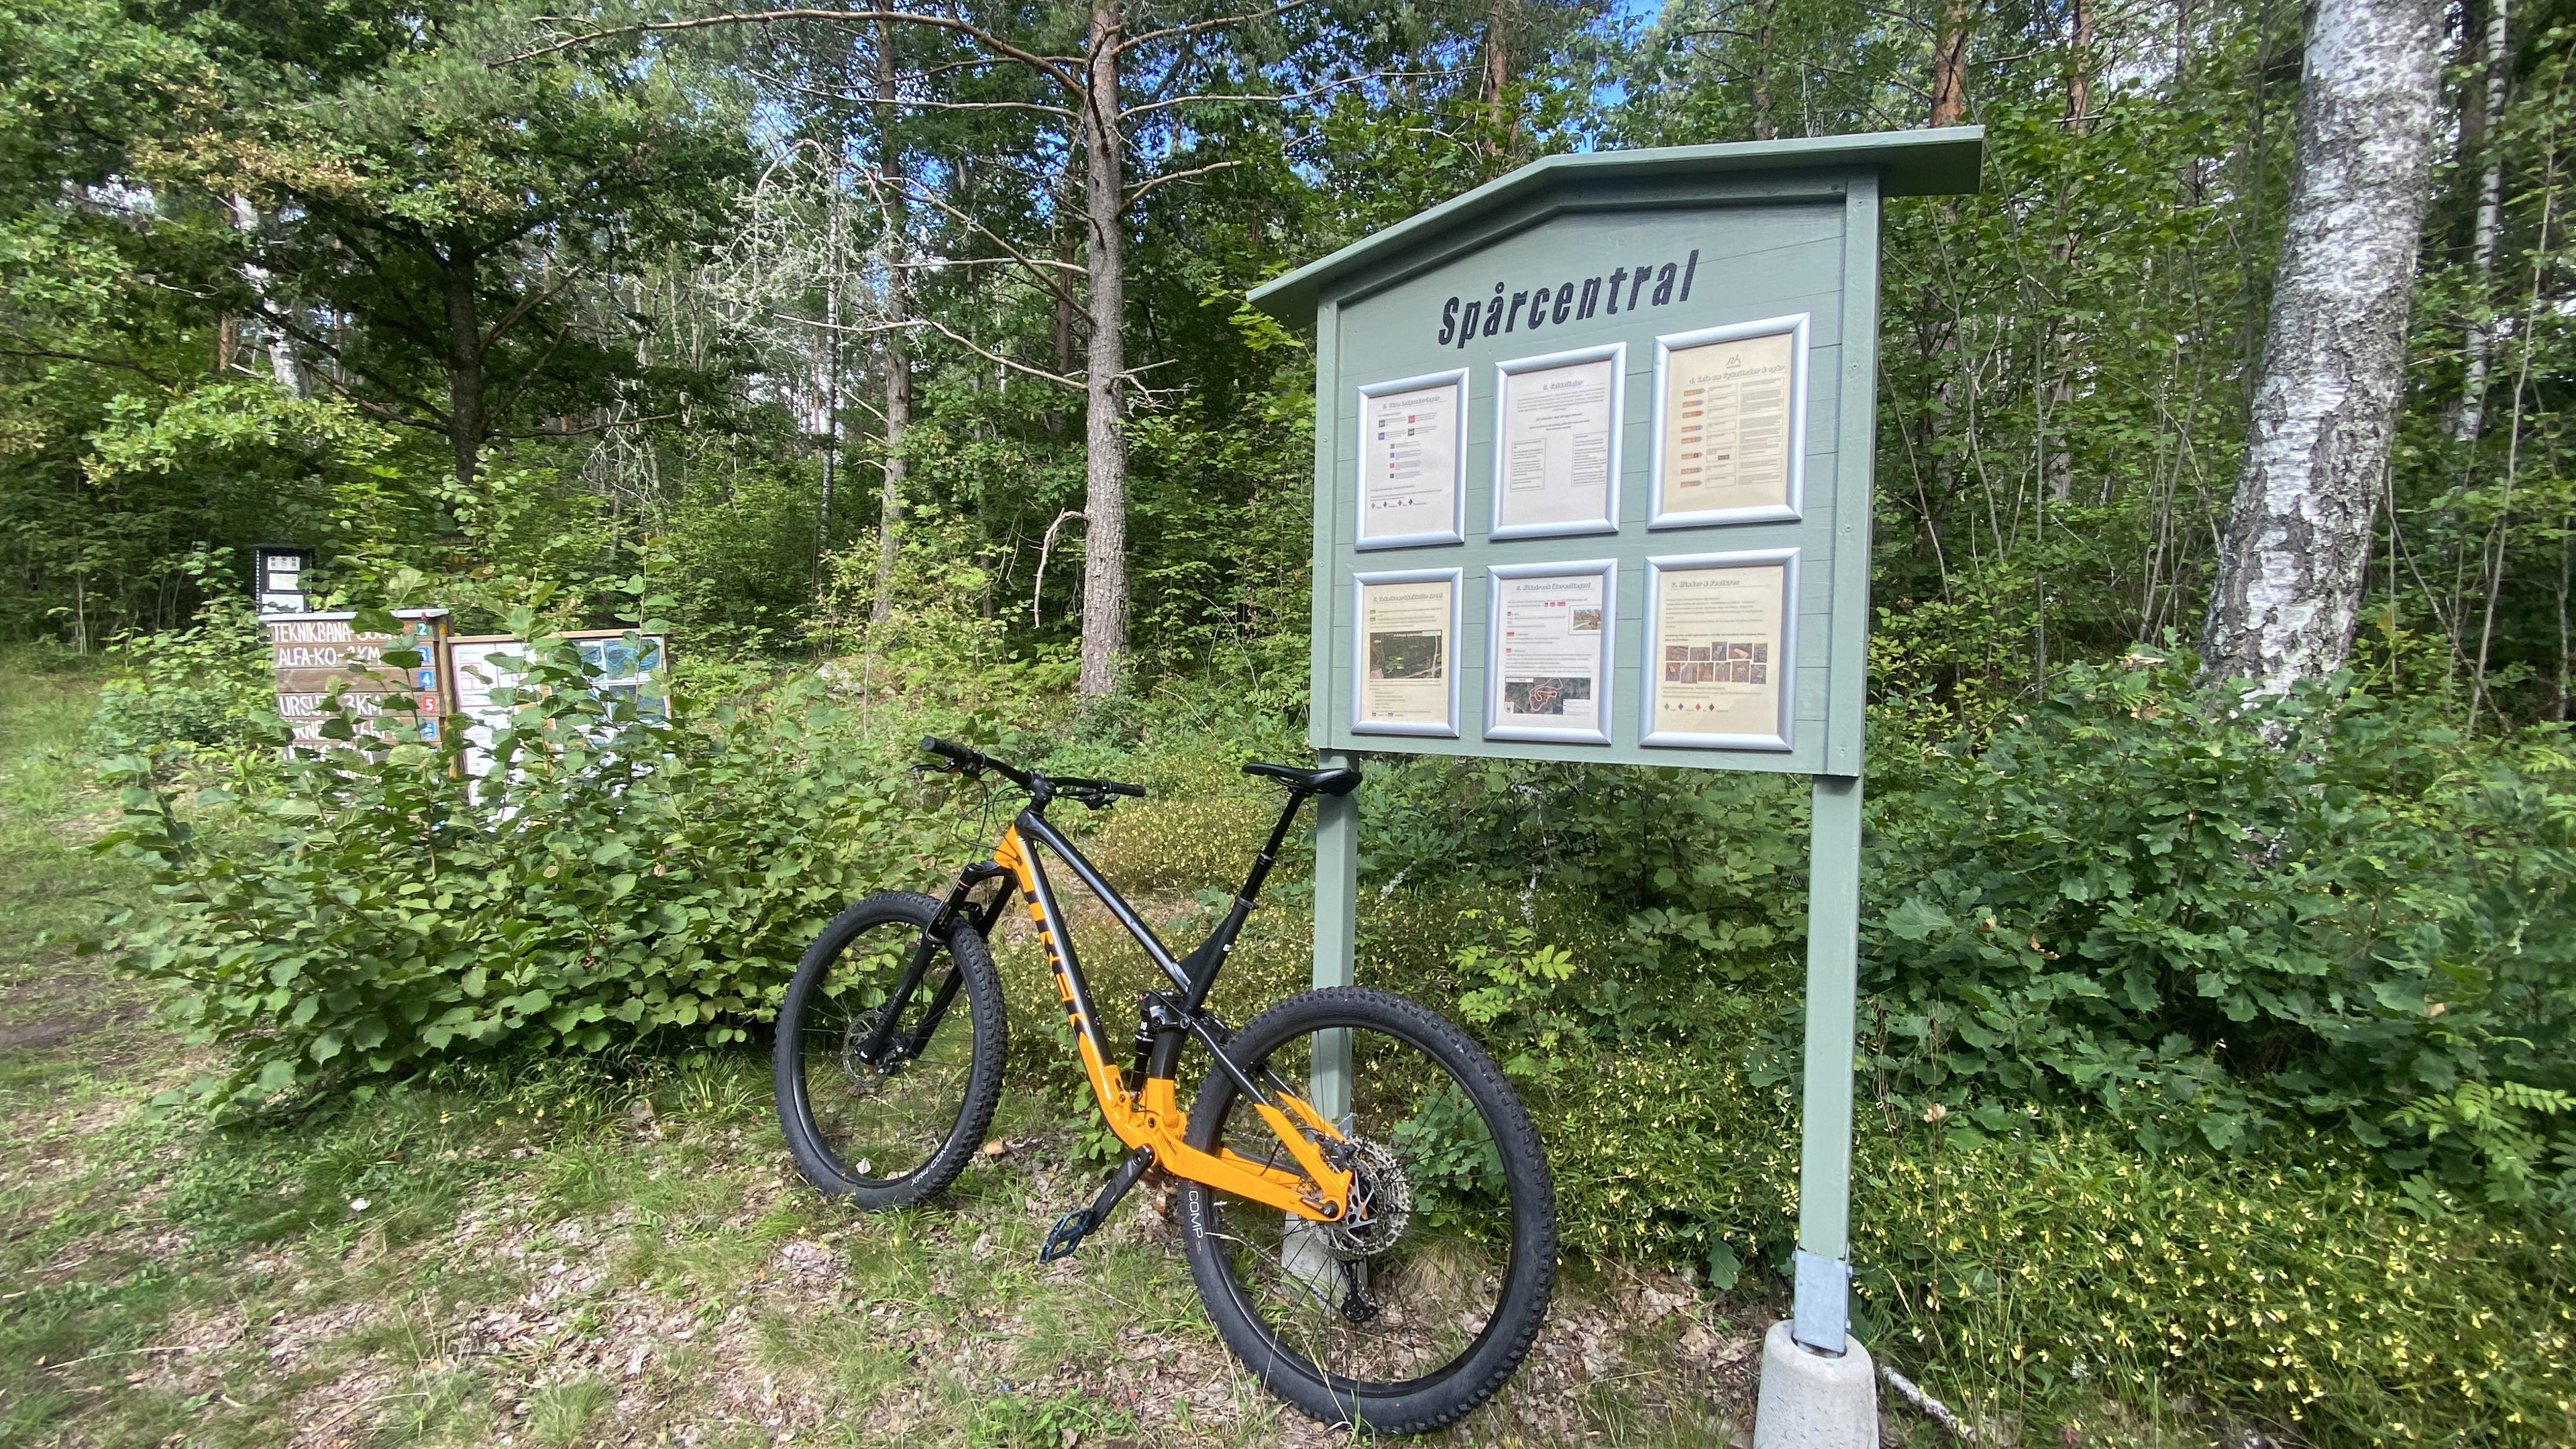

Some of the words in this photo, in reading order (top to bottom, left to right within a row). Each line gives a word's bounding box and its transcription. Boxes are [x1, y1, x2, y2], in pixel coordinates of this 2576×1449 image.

[1438, 249, 1699, 349] Spårcentral
[418, 623, 427, 635] 2
[422, 673, 431, 685] 4
[425, 698, 433, 711] 5
[931, 1136, 953, 1169] COMP
[1189, 1191, 1203, 1238] COMP
